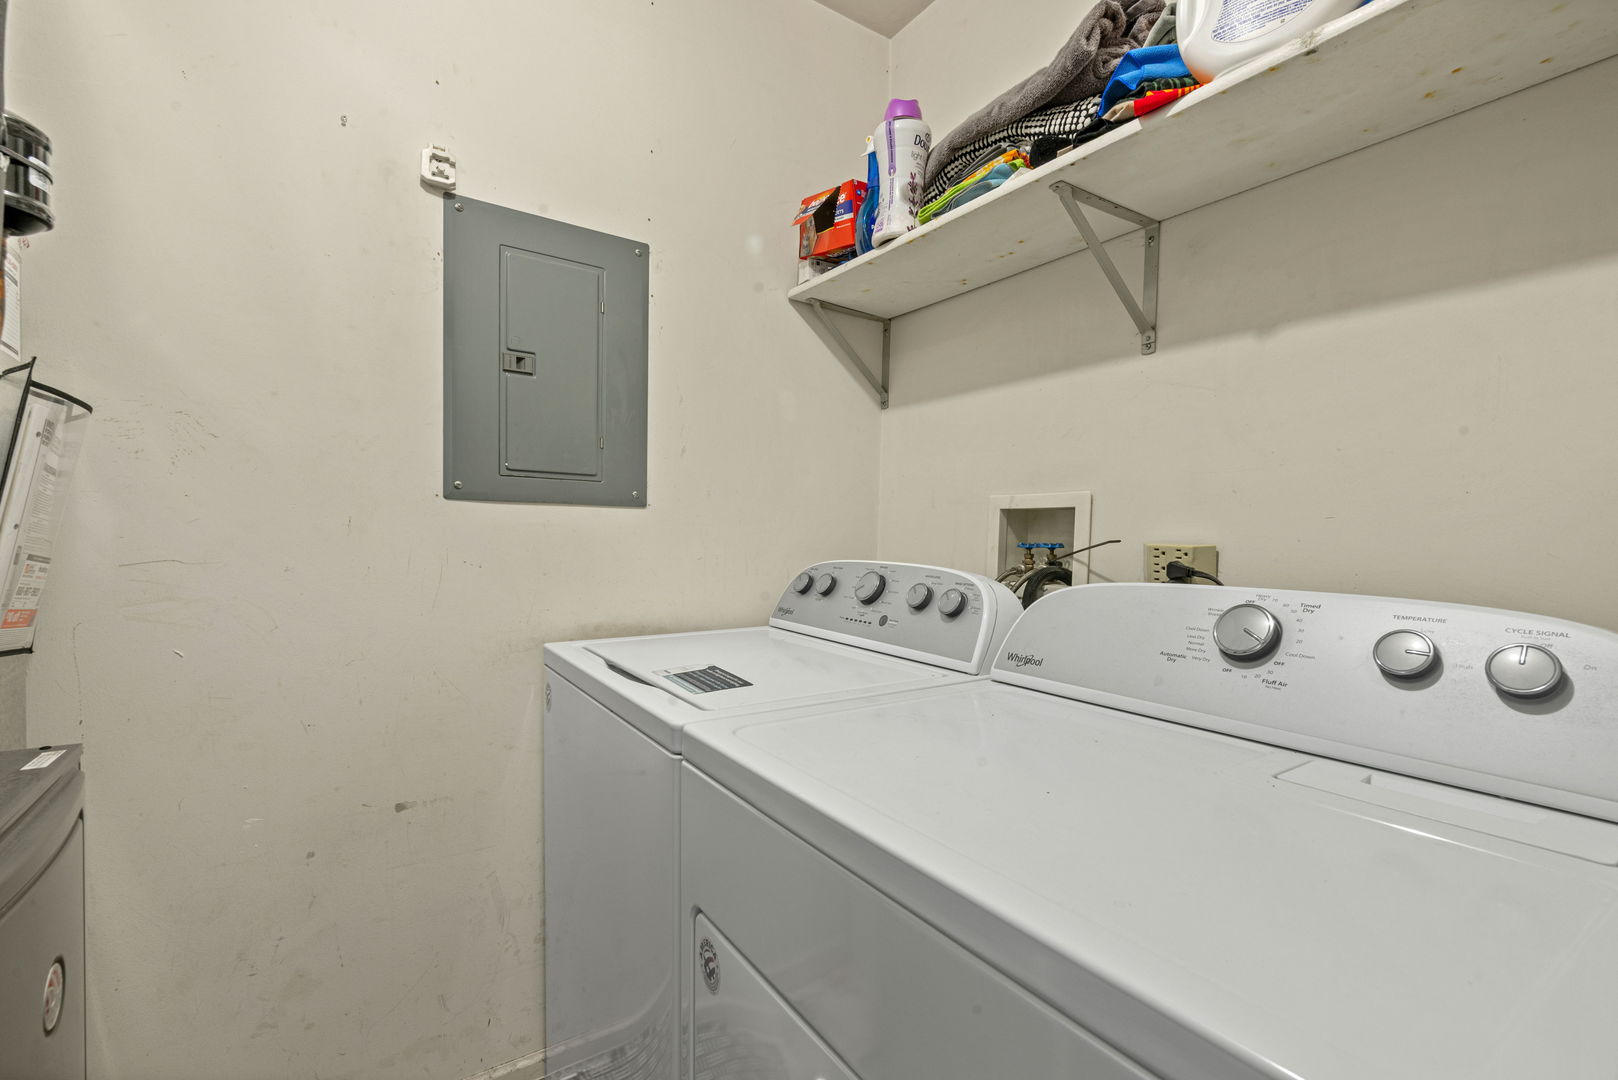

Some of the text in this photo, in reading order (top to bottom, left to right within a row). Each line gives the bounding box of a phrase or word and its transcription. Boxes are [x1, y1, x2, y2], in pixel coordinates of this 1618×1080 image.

[1393, 614, 1448, 624] TEMPERATURE
[1505, 627, 1572, 638] CYCLE SIGNAL
[1008, 652, 1044, 667] Whirlpool
[1160, 651, 1186, 659] Automatic
